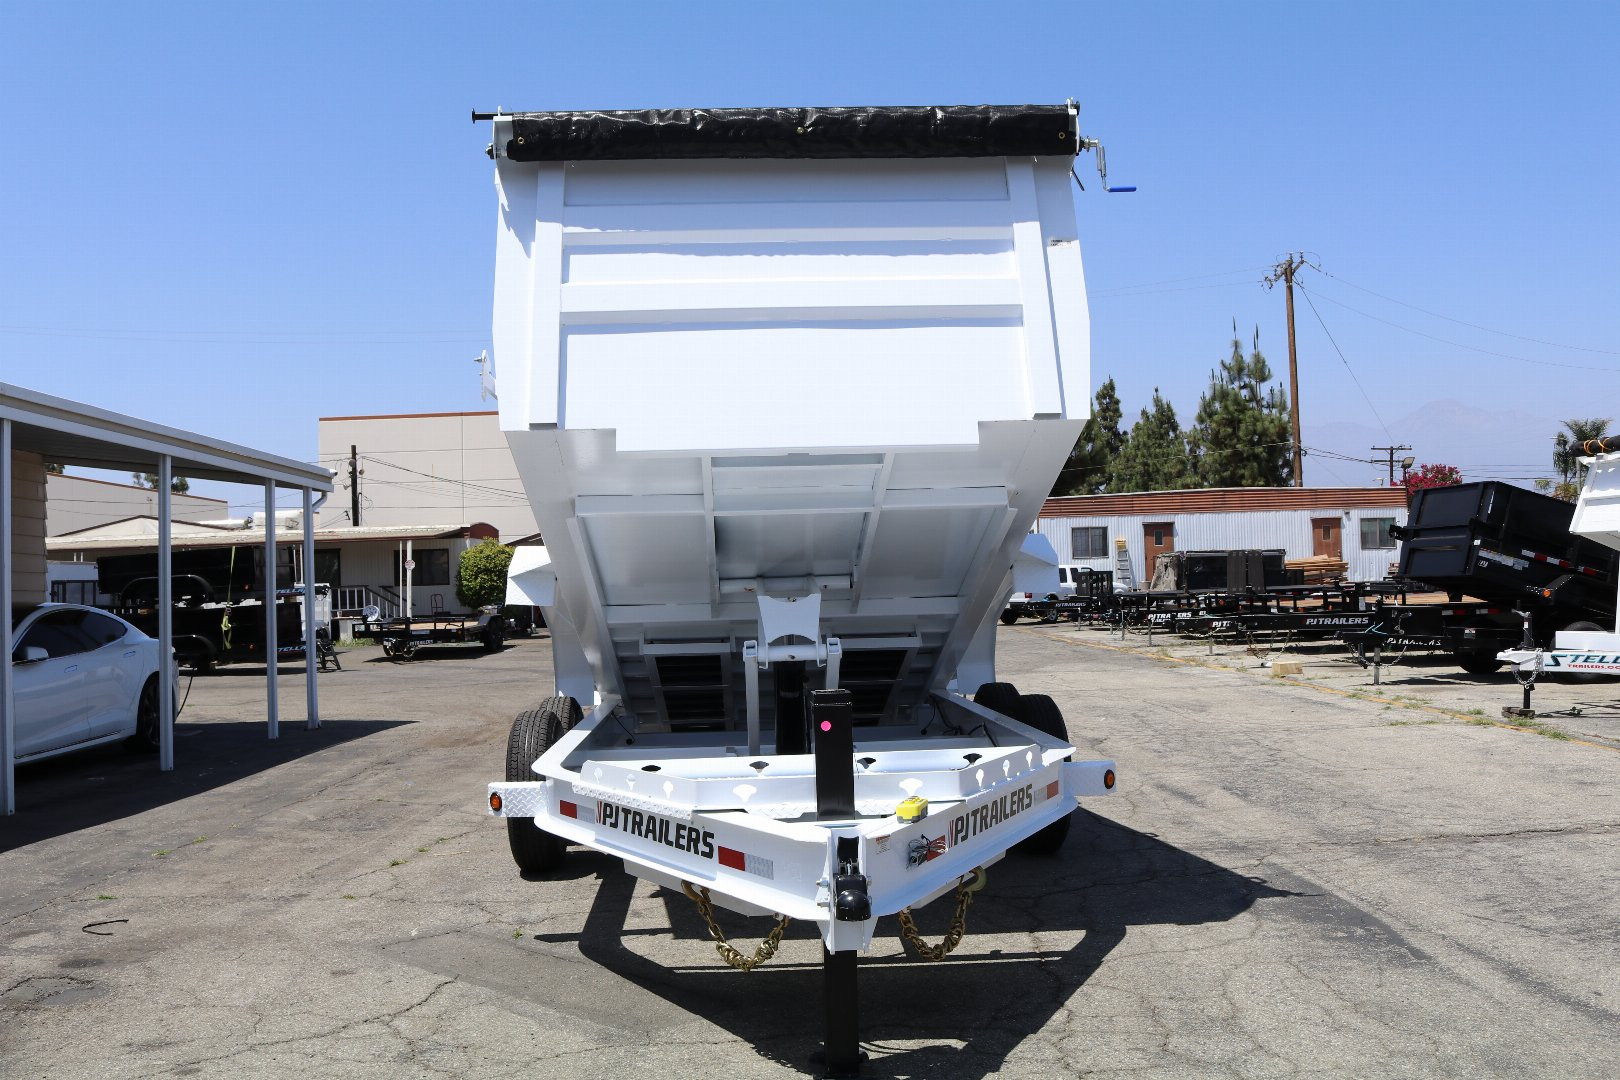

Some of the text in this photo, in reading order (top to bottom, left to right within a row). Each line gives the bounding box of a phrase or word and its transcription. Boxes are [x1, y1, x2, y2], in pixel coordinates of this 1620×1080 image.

[1318, 616, 1369, 625] TRAILERS
[621, 807, 715, 860] TRAILERS
[971, 783, 1033, 837] TRAILERS
